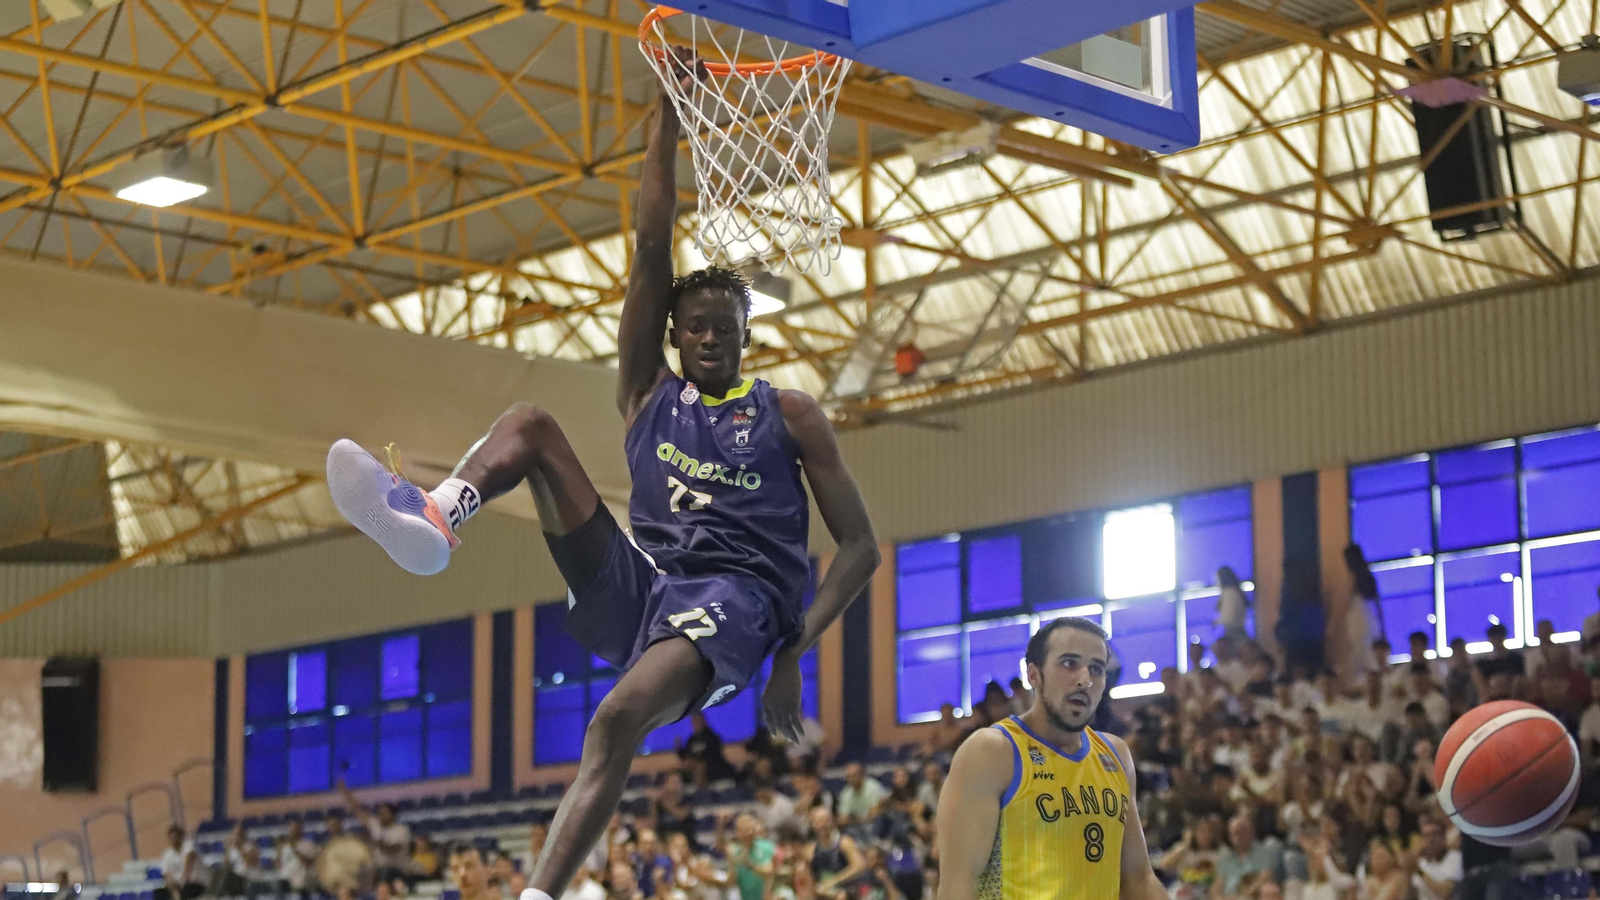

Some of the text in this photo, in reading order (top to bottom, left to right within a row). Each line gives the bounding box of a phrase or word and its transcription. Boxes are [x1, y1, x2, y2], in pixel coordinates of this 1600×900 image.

[656, 442, 762, 491] amex.io
[1033, 769, 1056, 781] vive
[1035, 784, 1129, 825] CANOE
[1083, 822, 1105, 863] 8
